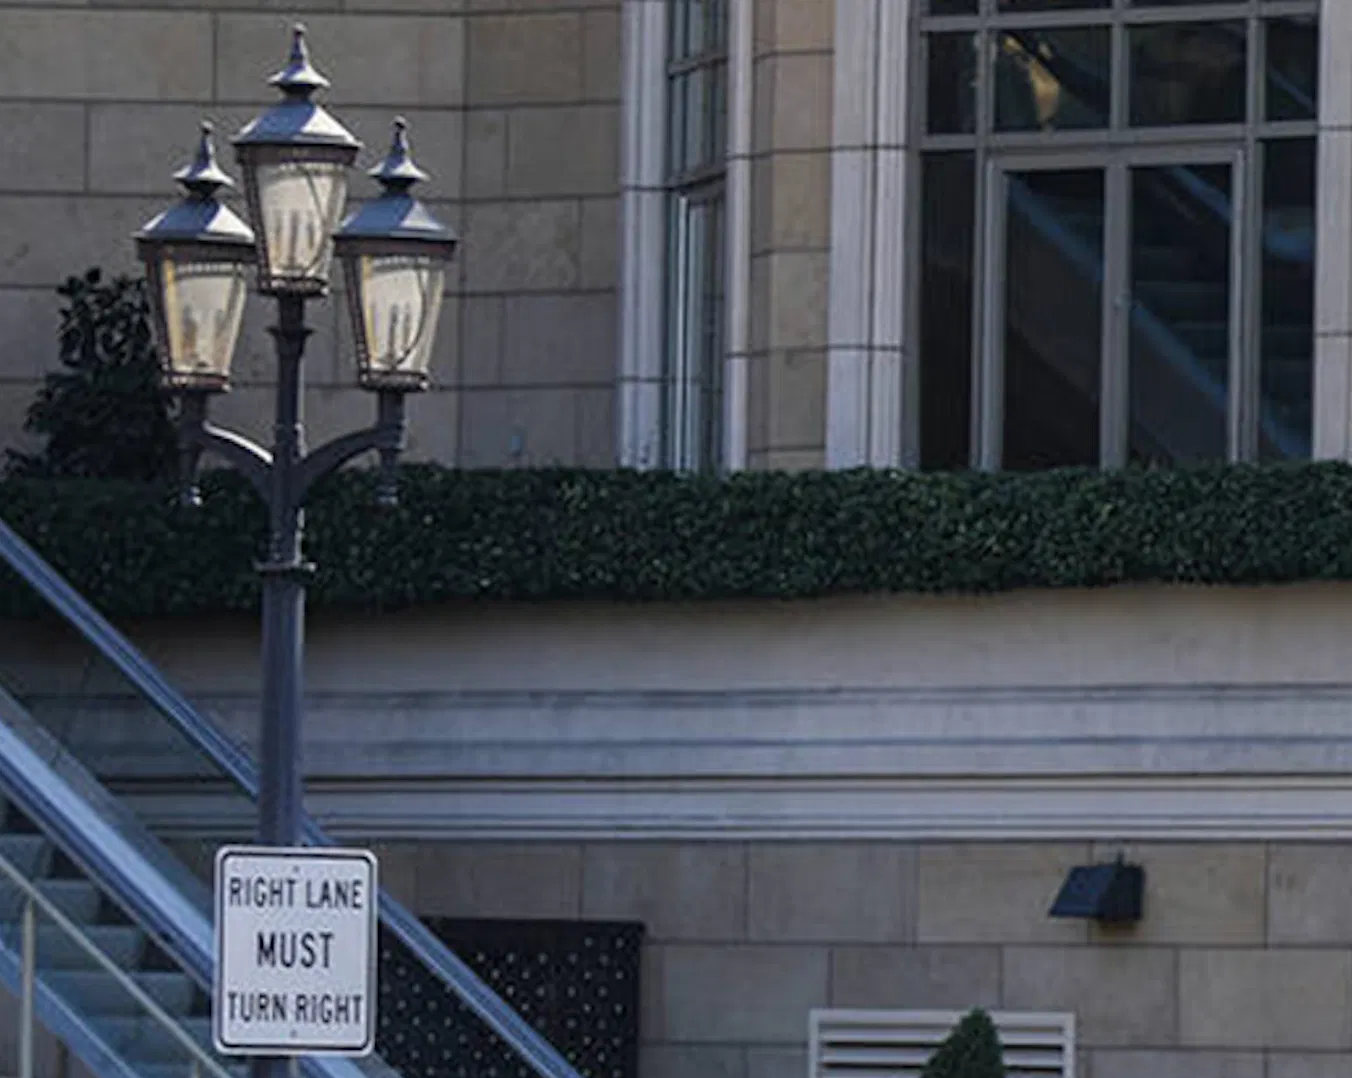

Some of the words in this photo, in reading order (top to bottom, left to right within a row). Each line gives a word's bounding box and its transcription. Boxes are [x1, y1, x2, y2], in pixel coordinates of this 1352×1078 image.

[229, 876, 297, 909] RIGHT
[306, 879, 364, 910] LANE
[257, 931, 334, 969] MUST
[227, 991, 289, 1022] TURN
[295, 994, 363, 1025] RIGHT
